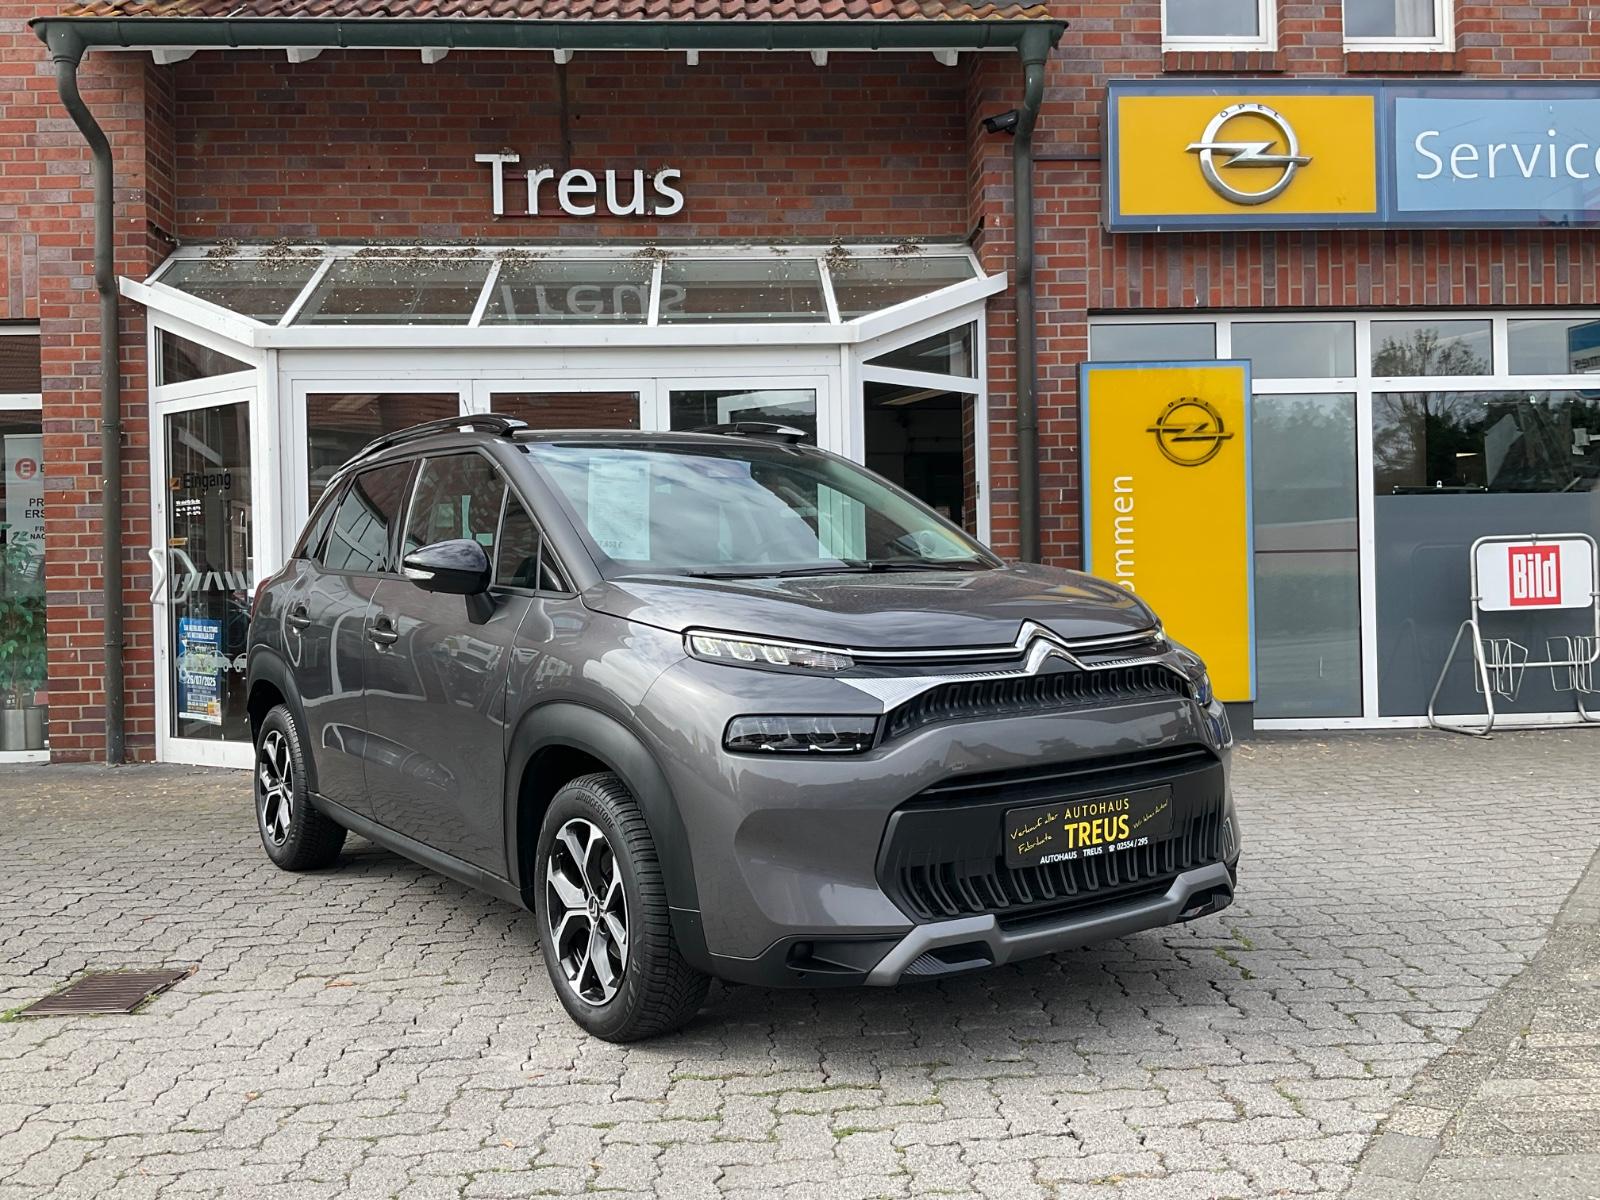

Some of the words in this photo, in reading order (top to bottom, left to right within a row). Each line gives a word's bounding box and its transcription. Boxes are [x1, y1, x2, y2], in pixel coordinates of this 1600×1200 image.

[1220, 104, 1280, 119] OPEL
[1415, 129, 1600, 179] Servic
[475, 154, 685, 216] Treus
[1167, 397, 1209, 408] OPEL
[183, 473, 231, 492] Eingang
[1512, 553, 1558, 599] Bild
[575, 791, 616, 830] BRIDGESTONE
[1064, 798, 1130, 820] AUTOHAUS
[1010, 817, 1042, 840] Verkauf
[1064, 814, 1130, 849] TREUS
[1017, 833, 1053, 855] Fabrikate
[1040, 851, 1078, 865] AUTOHAUS
[1083, 847, 1103, 857] TREUS
